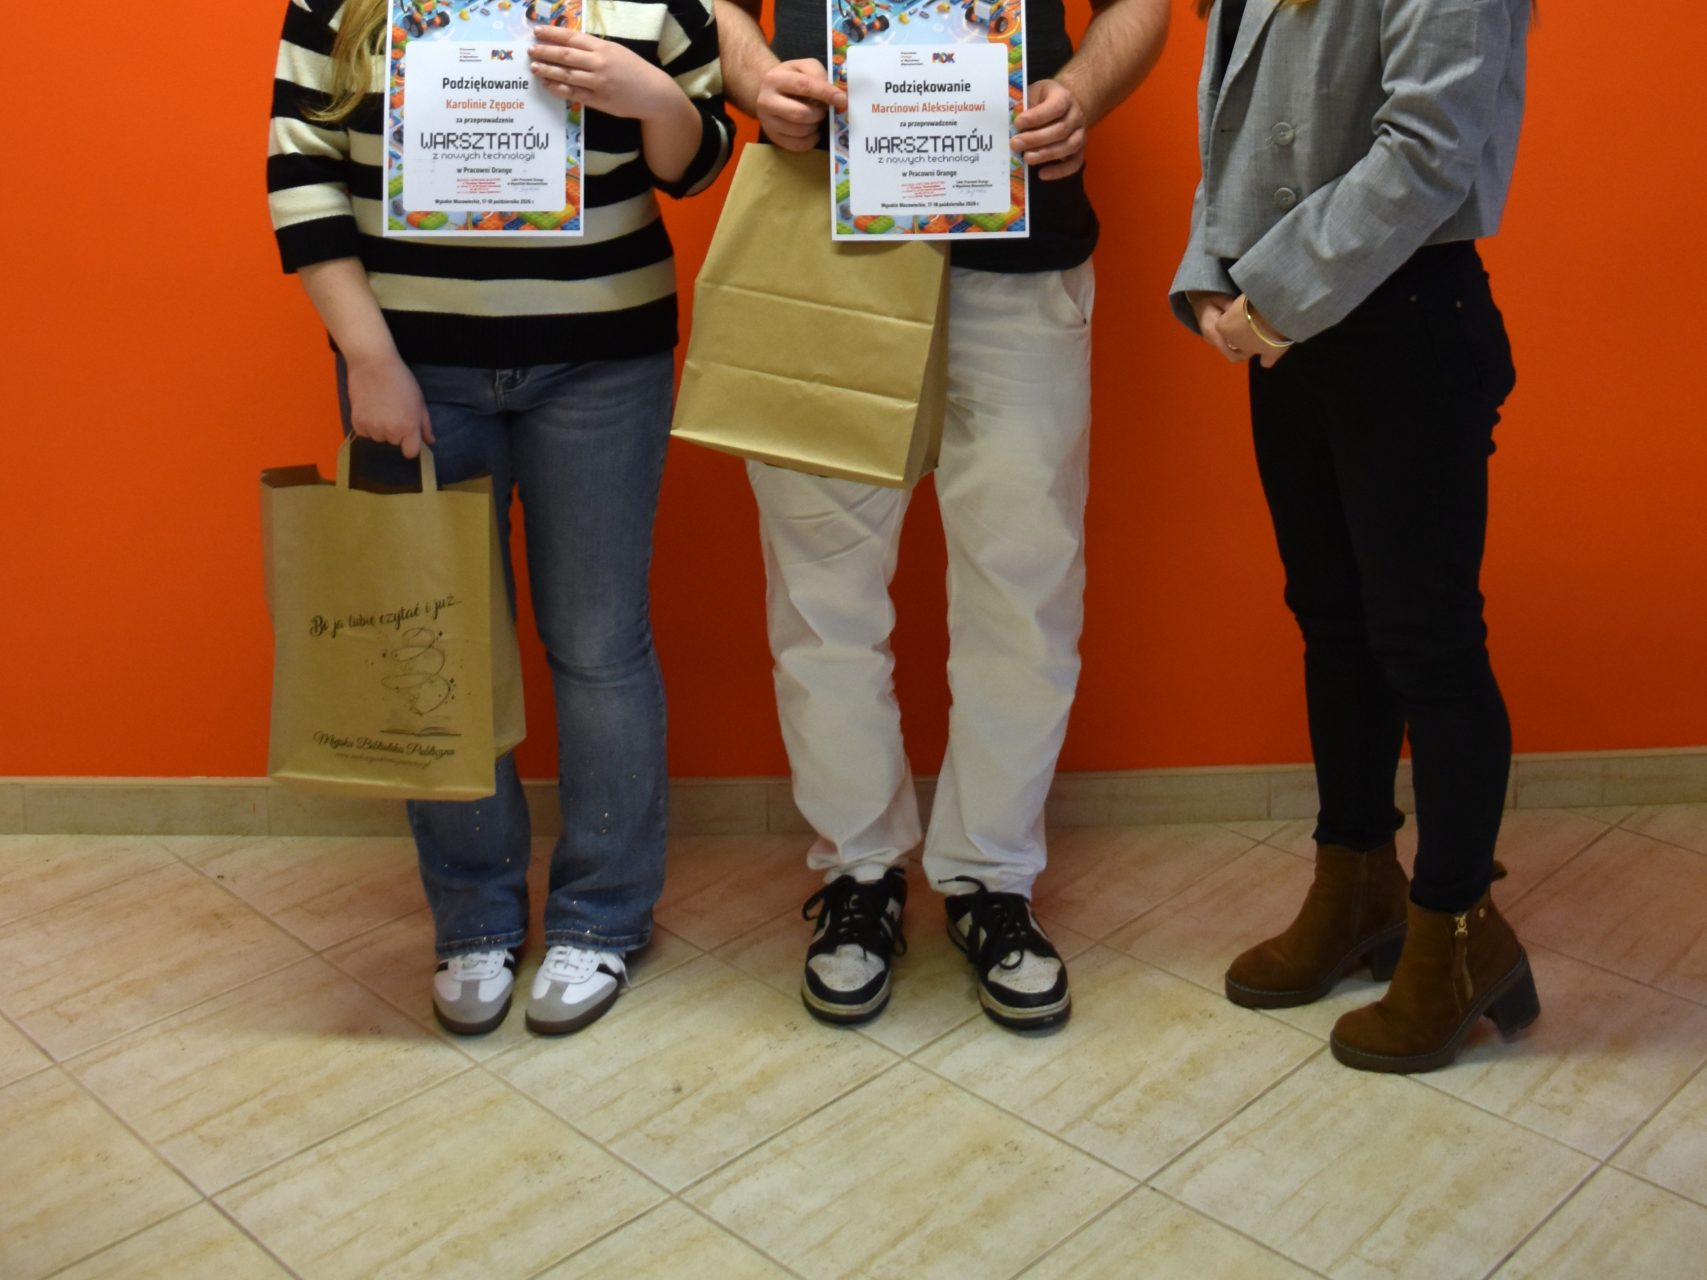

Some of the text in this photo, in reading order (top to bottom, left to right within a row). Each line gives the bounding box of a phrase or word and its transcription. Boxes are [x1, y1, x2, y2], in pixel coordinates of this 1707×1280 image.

[442, 76, 529, 92] Podziękowanie
[884, 79, 972, 96] Podziękowanie
[445, 98, 487, 110] Karolinie
[871, 100, 986, 115] Marcinowi Aleksiejukowi
[464, 116, 515, 125] przeprowadzenie
[907, 119, 958, 129] przeprowadzenie
[420, 125, 550, 150] WARSZTATÓW
[865, 127, 993, 154] WARSZTATÓW
[441, 151, 481, 161] nowych
[482, 151, 535, 161] technologii
[886, 155, 926, 165] nowych
[927, 153, 980, 164] technologii
[379, 602, 420, 630] czytać
